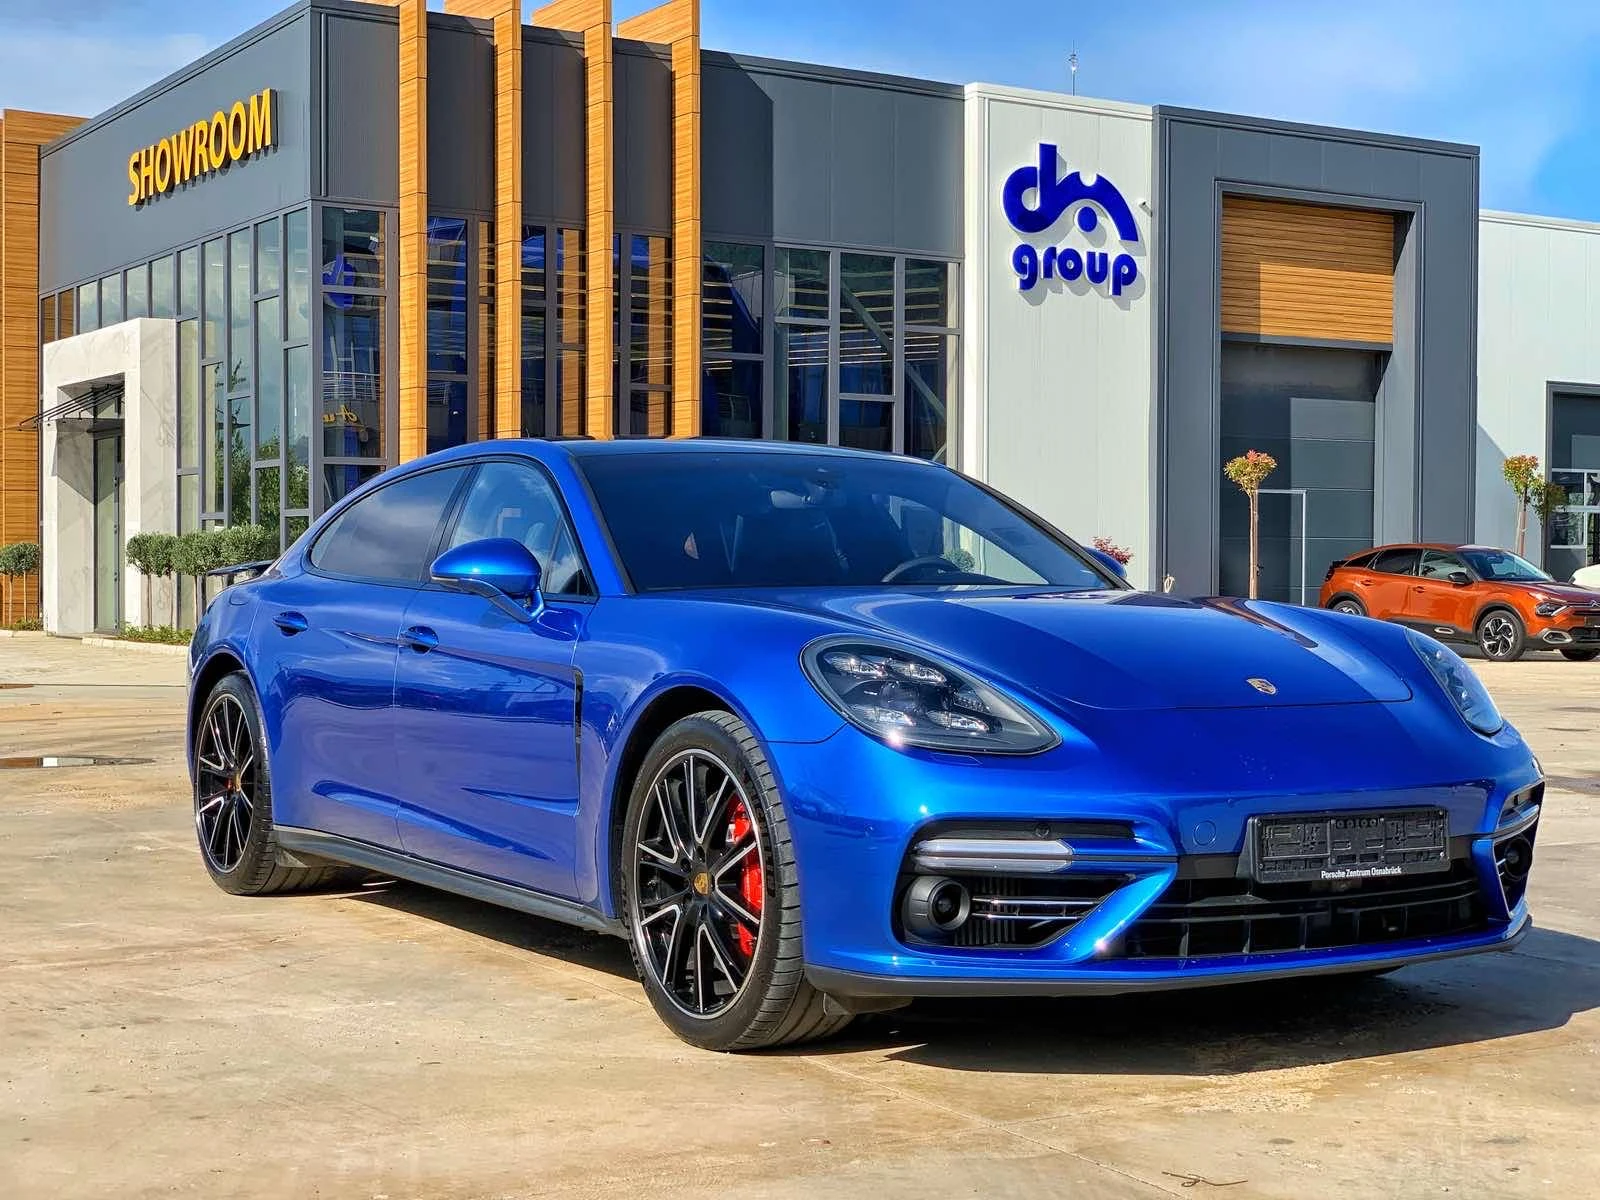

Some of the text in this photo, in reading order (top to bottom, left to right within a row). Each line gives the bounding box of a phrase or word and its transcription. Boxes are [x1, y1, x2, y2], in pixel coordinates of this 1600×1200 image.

[128, 88, 272, 205] SHOWROOM
[1012, 244, 1137, 296] group
[1321, 870, 1346, 879] Porsche
[1346, 868, 1371, 877] Zentrum
